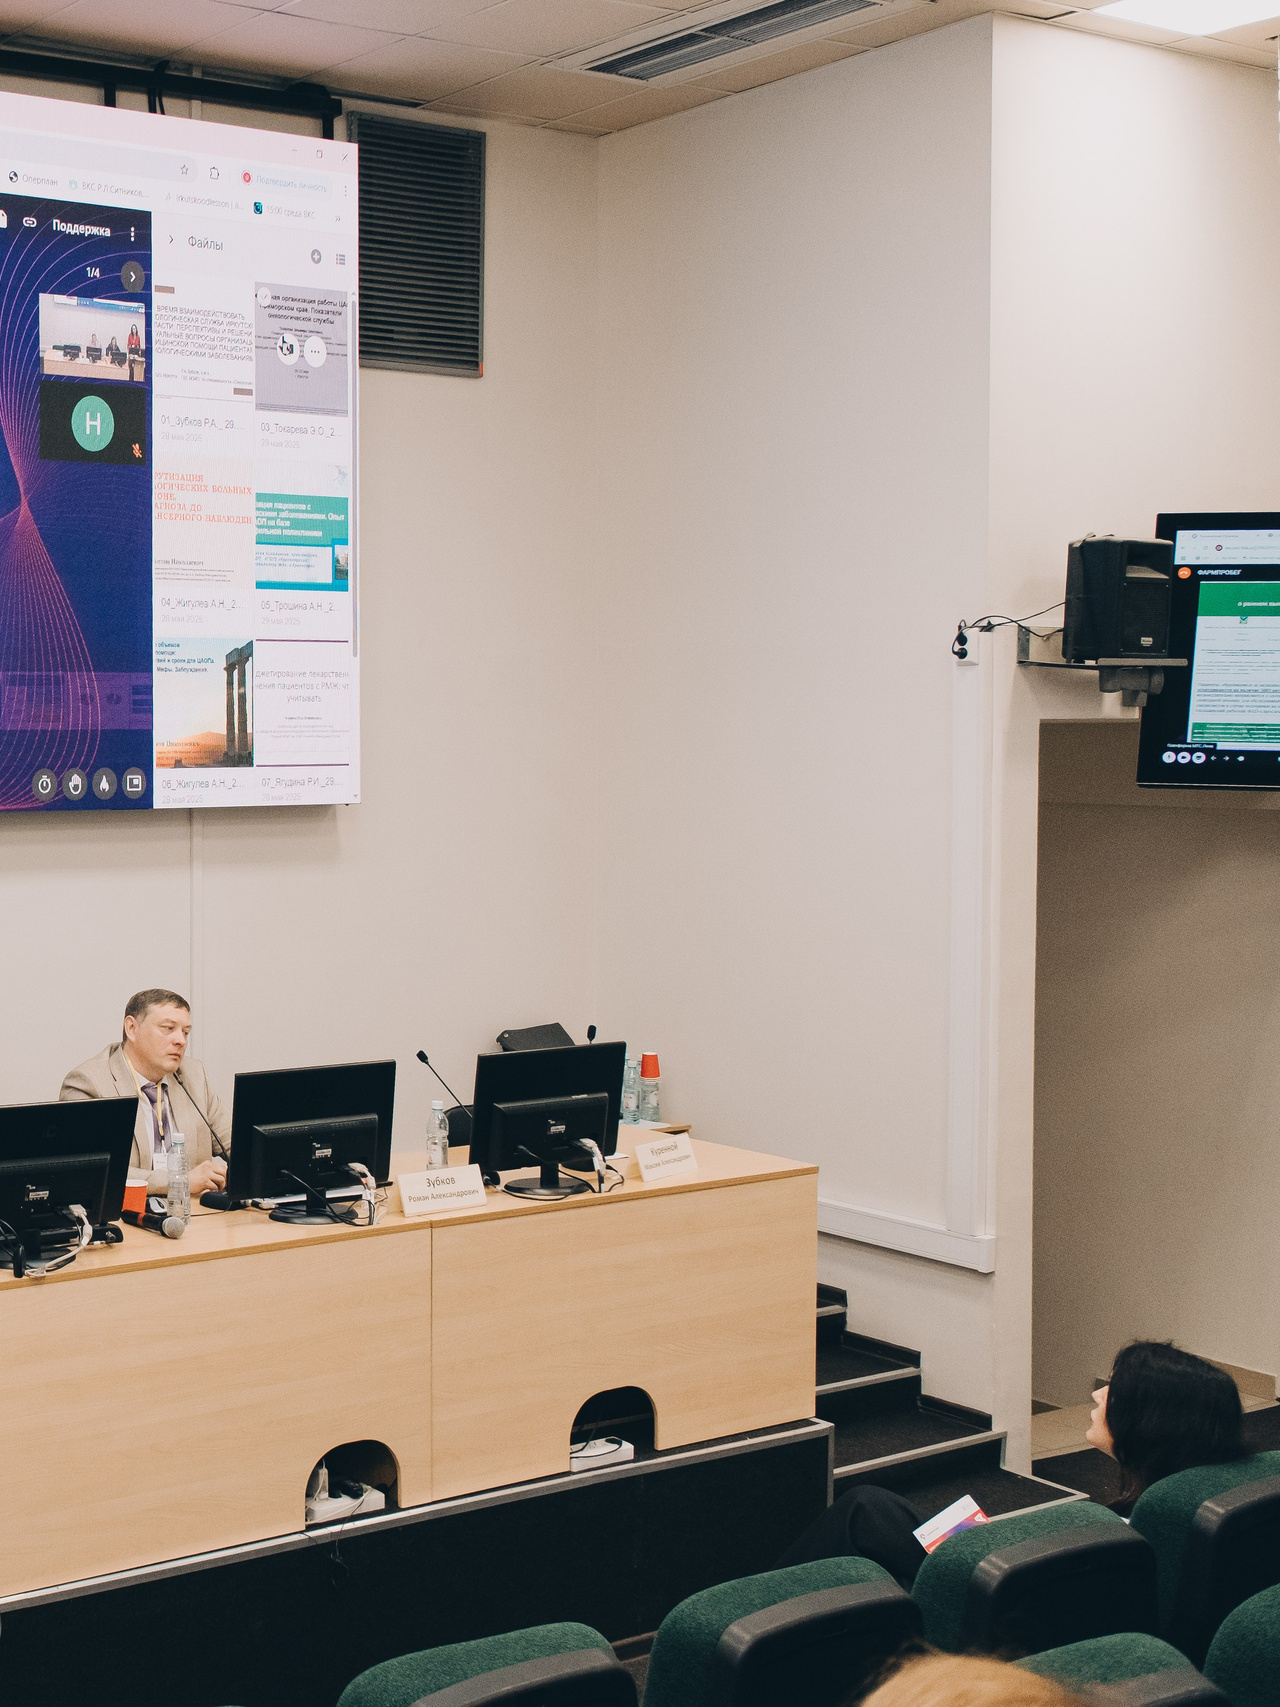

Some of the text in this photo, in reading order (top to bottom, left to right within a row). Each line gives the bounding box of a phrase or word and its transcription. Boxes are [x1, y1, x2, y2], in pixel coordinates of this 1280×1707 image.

[22, 173, 58, 187] Оперплан
[82, 182, 96, 192] ВКС
[52, 218, 111, 238] Поддержка
[188, 235, 224, 251] Файлы
[86, 266, 100, 279] 1/4
[650, 1141, 678, 1156] Куренной
[426, 1176, 456, 1188] Зубков
[408, 1188, 479, 1203] Роман Александрович
